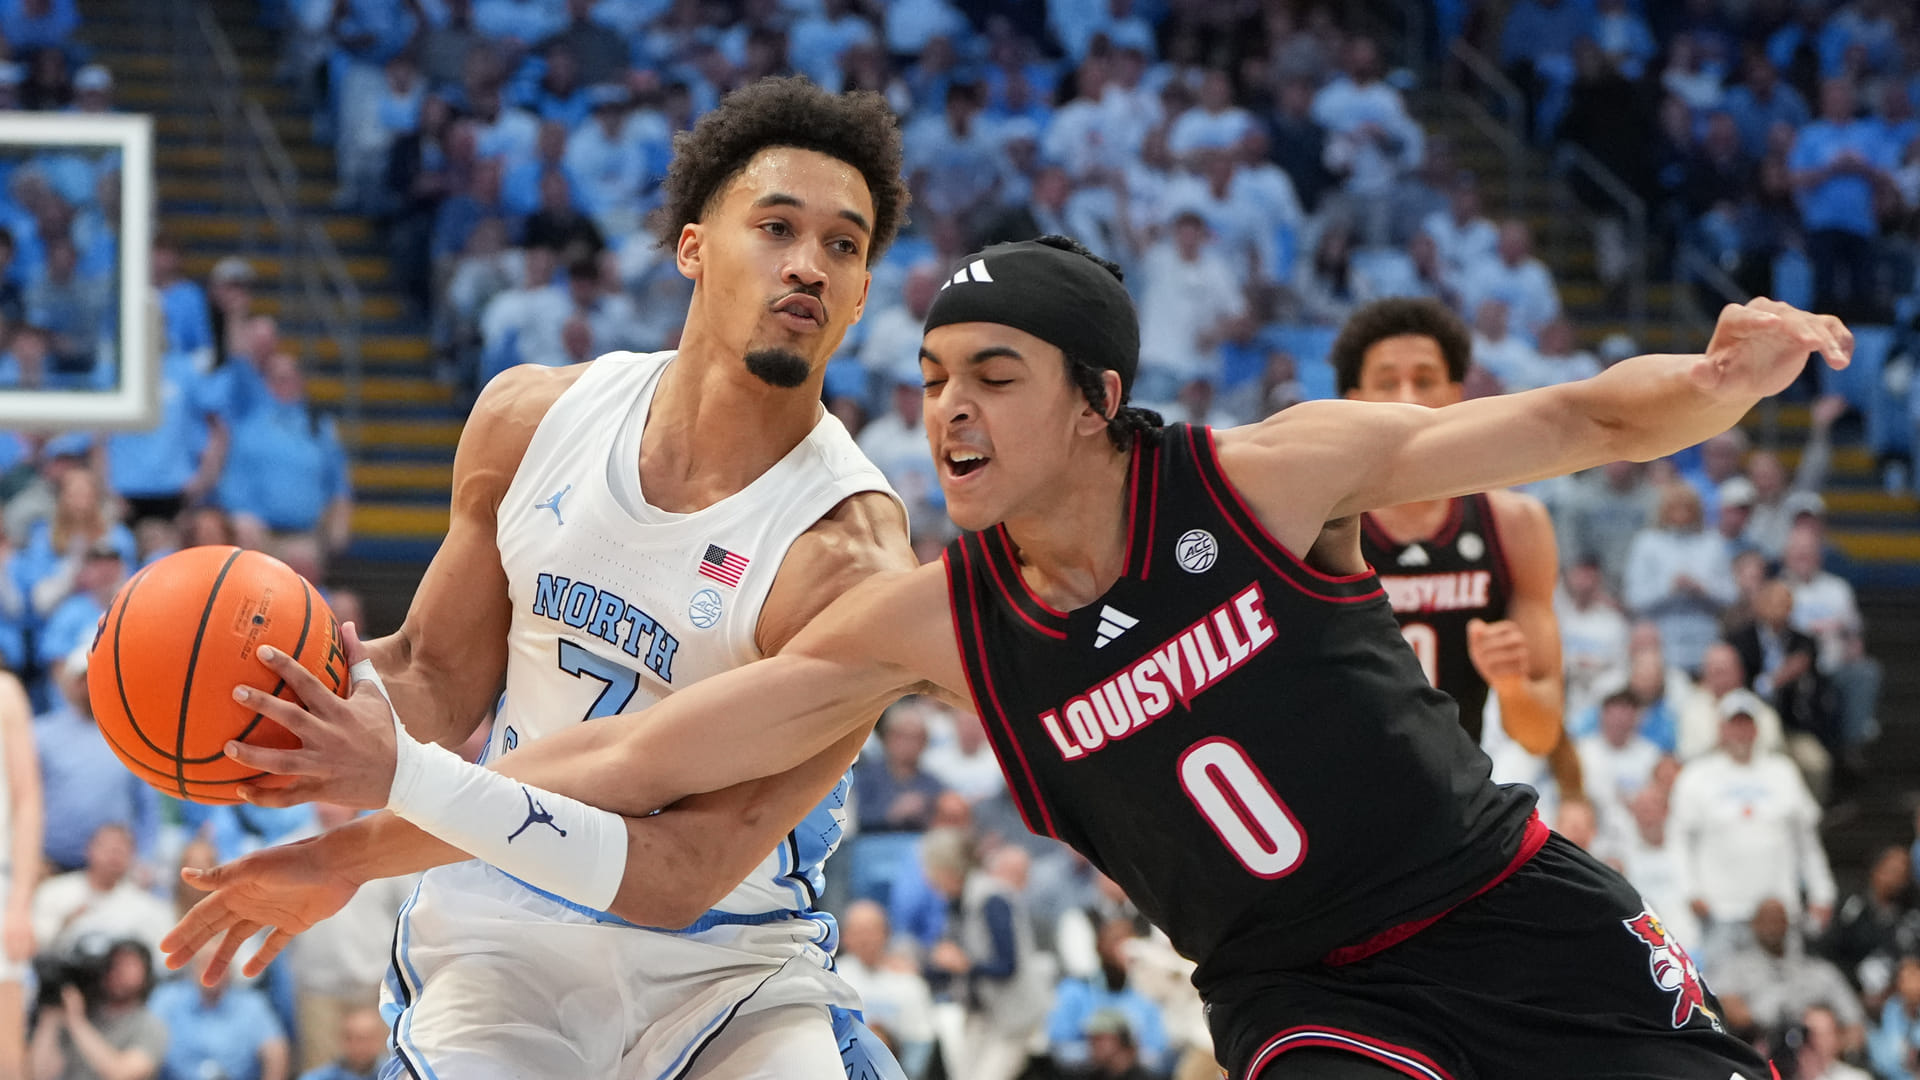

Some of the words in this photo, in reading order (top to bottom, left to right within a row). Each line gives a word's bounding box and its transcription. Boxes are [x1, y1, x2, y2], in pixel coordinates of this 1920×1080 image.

[1184, 537, 1212, 560] ACC
[532, 573, 680, 684] NORTH
[694, 600, 721, 616] ACC
[558, 638, 641, 722] 7
[1038, 580, 1280, 762] LOUISVILLE
[1176, 735, 1308, 881] 0
